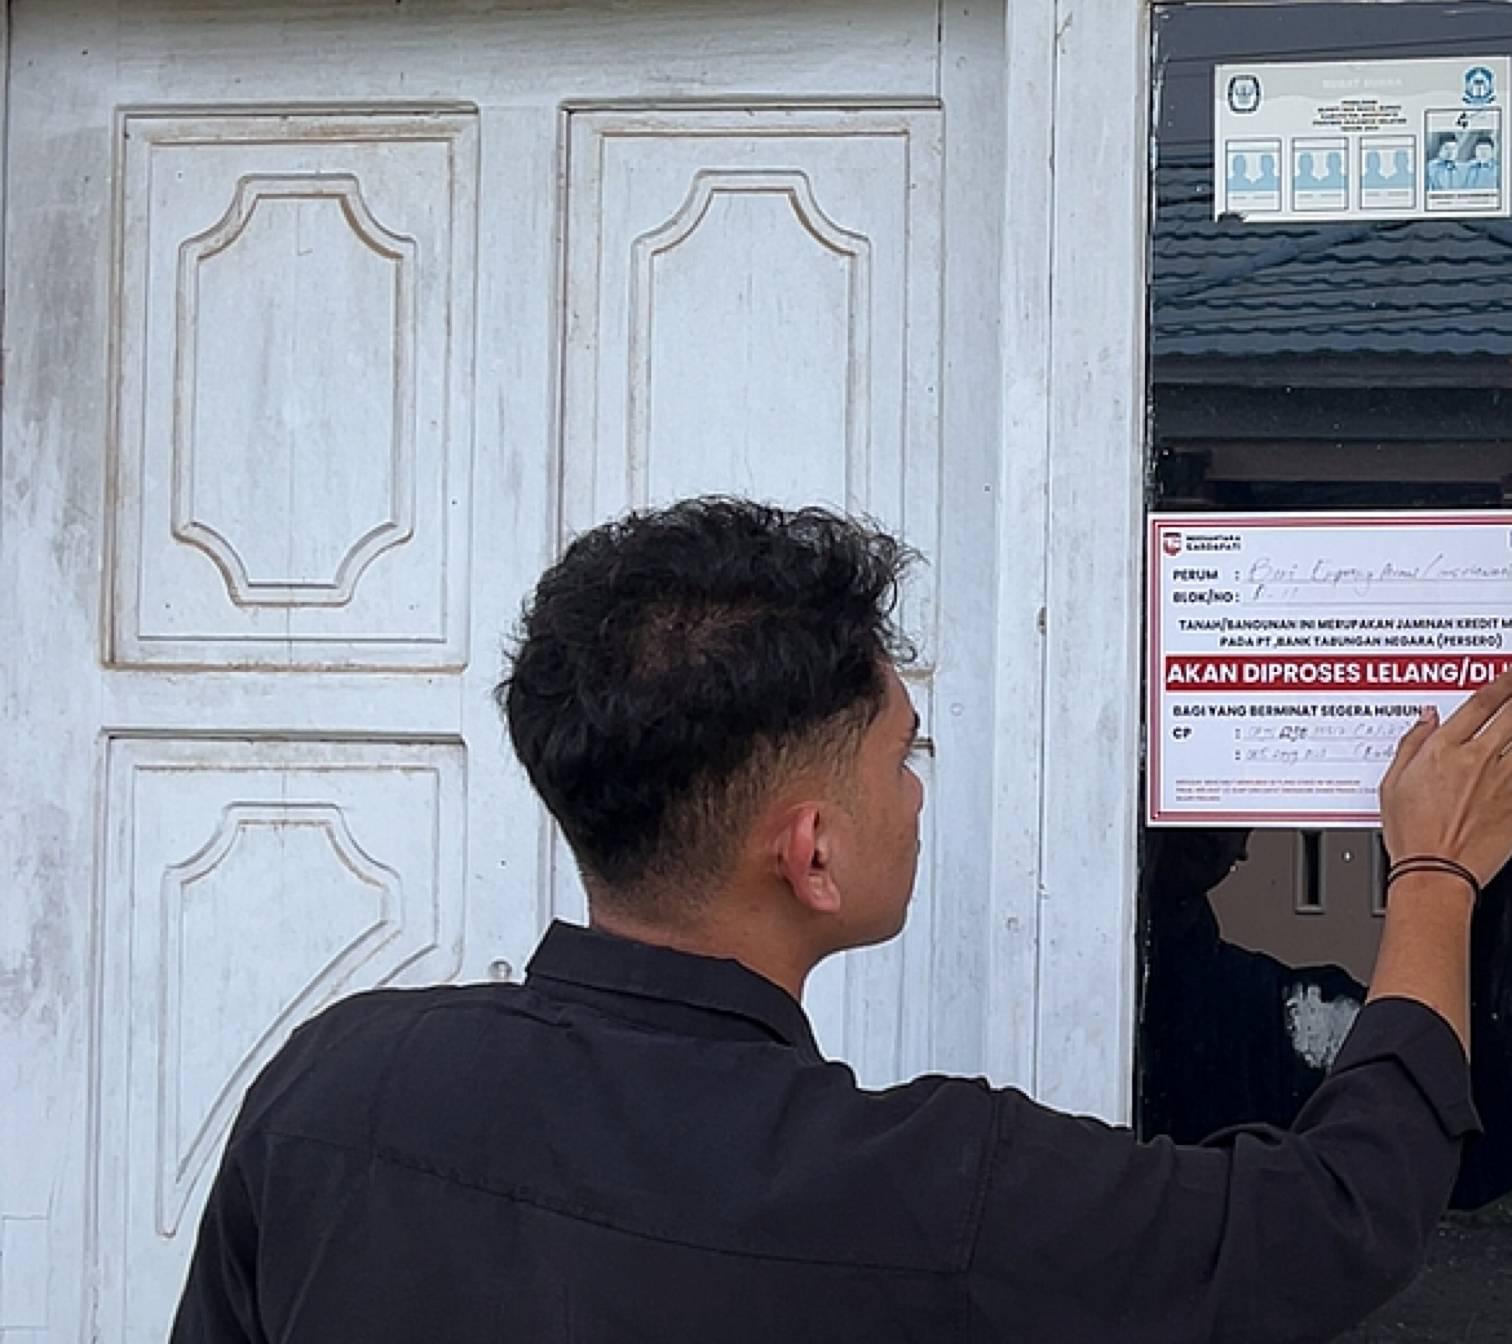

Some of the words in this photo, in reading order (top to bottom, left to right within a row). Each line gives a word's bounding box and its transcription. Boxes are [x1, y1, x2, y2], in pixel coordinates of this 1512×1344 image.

[1173, 570, 1218, 581] PERUM
[1318, 618, 1394, 629] MERUPAKAN
[1397, 618, 1453, 629] JAMINAN
[1456, 618, 1498, 629] KREDIT
[1219, 636, 1254, 647] PADA
[1315, 636, 1380, 647] TABUNGAN
[1385, 635, 1434, 647] NEGARA
[1437, 633, 1502, 649] (PERSERO)
[1167, 663, 1237, 684] AKAN
[1243, 663, 1361, 684] DIPROSES
[1173, 705, 1205, 717] BAGI
[1208, 705, 1247, 717] YANG
[1250, 705, 1318, 717] BERMINAT
[1320, 705, 1373, 717] SEGERA
[1173, 727, 1192, 739] CP
